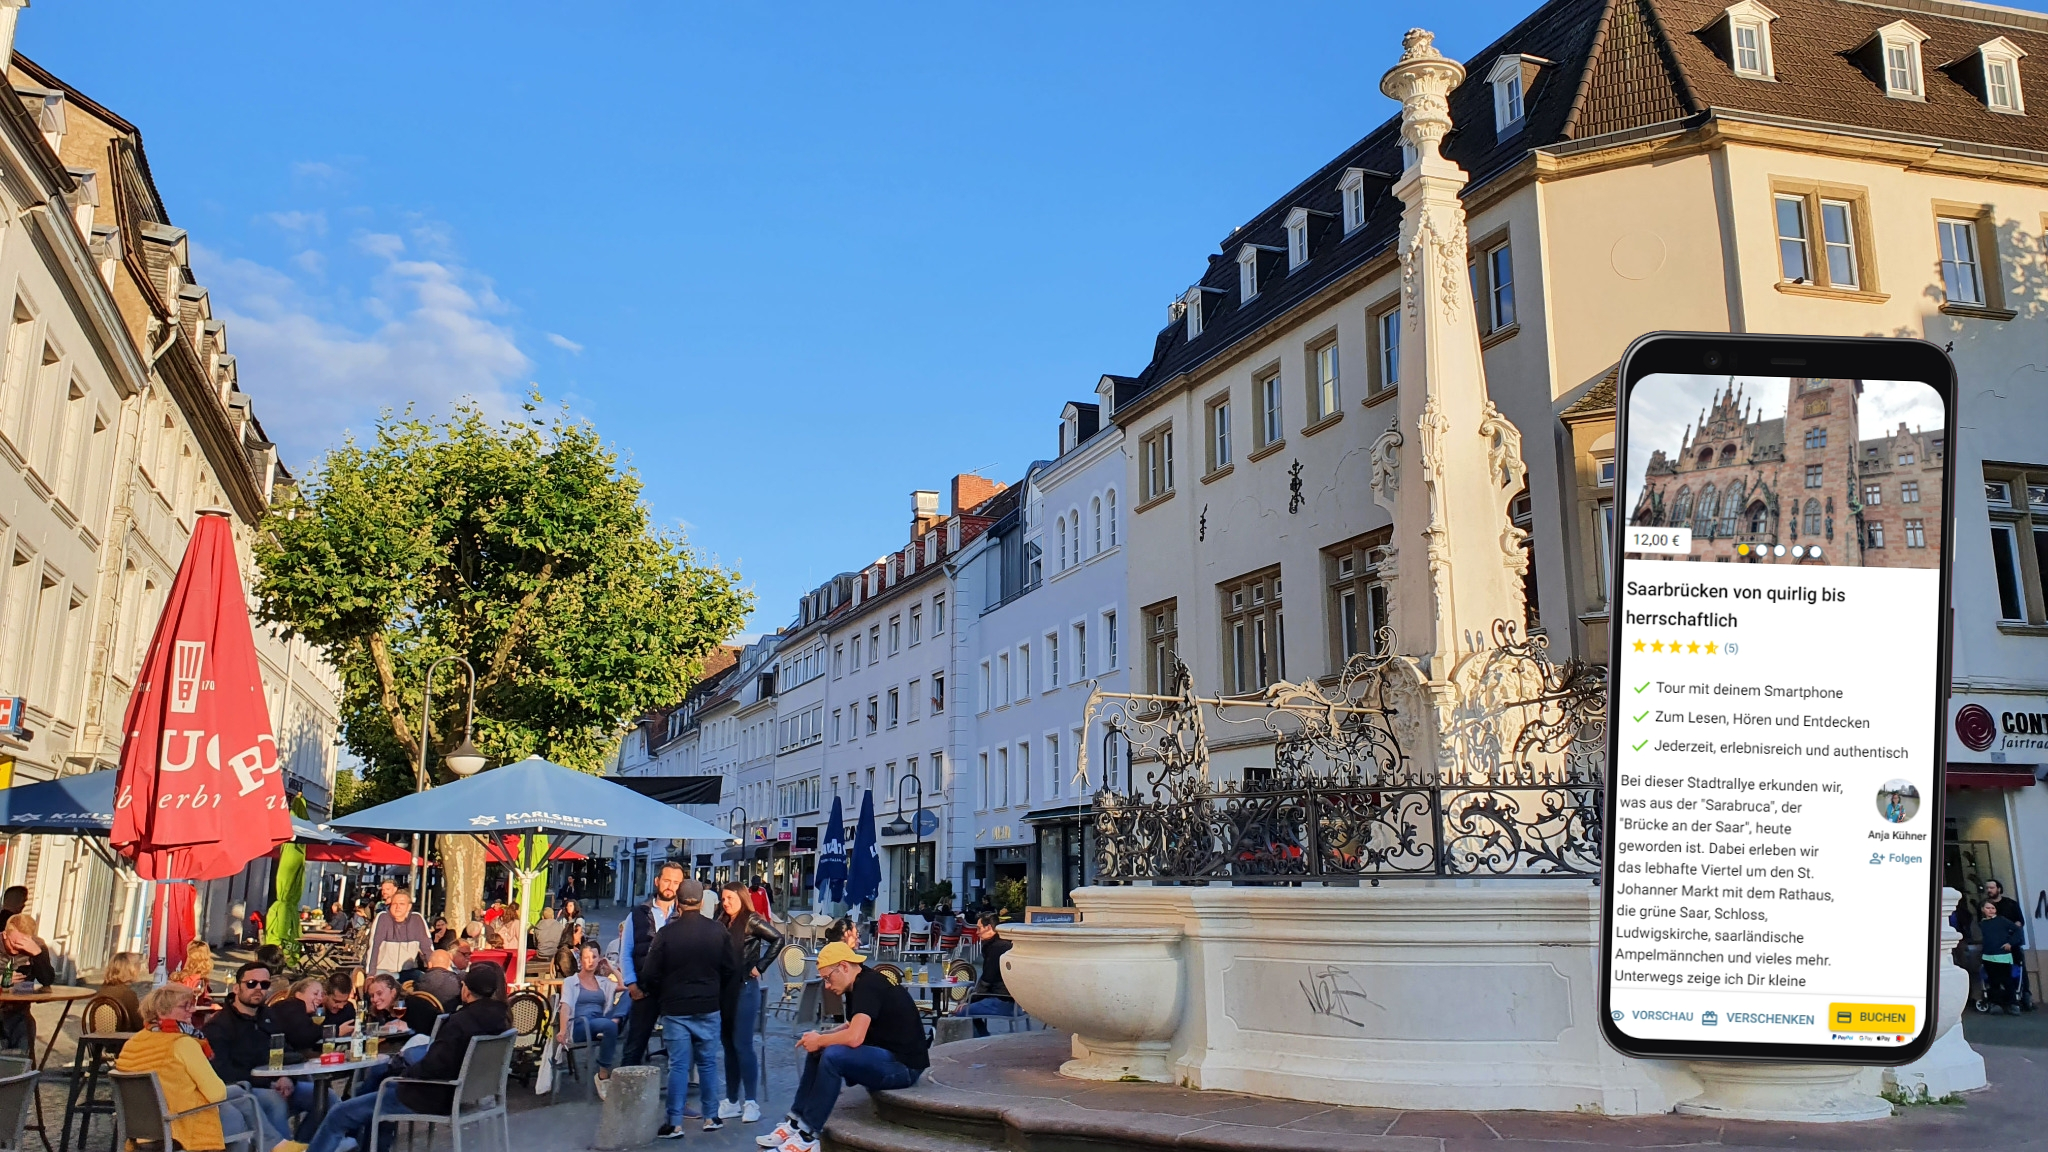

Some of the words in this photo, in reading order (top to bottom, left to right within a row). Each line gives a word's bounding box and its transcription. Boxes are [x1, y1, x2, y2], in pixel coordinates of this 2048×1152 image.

[1634, 534, 1668, 546] 12,00
[1671, 534, 1680, 546] €
[1627, 581, 1728, 598] Saarbrücken
[1733, 588, 1761, 599] von
[1767, 586, 1816, 604] quirlig
[1822, 587, 1845, 602] bis
[1626, 610, 1737, 627] herrschaftlich
[1724, 642, 1739, 655] (5)
[1656, 682, 1685, 693] Tour
[1689, 683, 1709, 694] mit
[1714, 683, 1760, 696] deinem
[1765, 685, 1843, 700] Smartphone
[1655, 711, 1684, 722] Zum
[1689, 712, 1729, 725] Lesen,
[1734, 714, 1771, 725] Hören
[1776, 715, 1799, 726] und
[1804, 716, 1869, 728] Entdecken
[1655, 740, 1716, 754] Jederzeit,
[1720, 742, 1801, 755] erlebnisreich
[1806, 745, 1829, 756] und
[1834, 746, 1908, 758] authentisch
[1621, 775, 1640, 786] Bei
[1645, 775, 1684, 787] dieser
[1688, 777, 1755, 792] Stadtrallye
[1759, 779, 1817, 791] erkunden
[1822, 782, 1843, 794] wir,
[1620, 799, 1646, 808] was
[1650, 800, 1672, 809] aus
[1677, 798, 1697, 810] der
[1701, 799, 1777, 814] "Sarabruca",
[1782, 802, 1802, 813] der
[50, 812, 114, 821] KARLS
[505, 811, 608, 827] KARLSBERG
[1620, 818, 1668, 830] "Brücke
[1672, 822, 1687, 831] an
[1691, 820, 1712, 832] der
[1716, 821, 1751, 834] Saar",
[1756, 822, 1791, 834] heute
[1868, 831, 1889, 841] Anja
[1893, 831, 1926, 840] Kühner
[1619, 841, 1681, 854] geworden
[1686, 842, 1704, 853] ist.
[1709, 843, 1744, 854] Dabei
[1749, 844, 1796, 856] erleben
[1800, 846, 1819, 856] wir
[1889, 854, 1922, 864] Folgen
[1618, 861, 1641, 873] das
[1646, 862, 1697, 875] lebhafte
[1701, 864, 1742, 876] Viertel
[1747, 868, 1766, 877] um
[1771, 866, 1793, 878] den
[1798, 867, 1813, 878] St.
[1617, 883, 1678, 896] Johanner
[1682, 885, 1718, 897] Markt
[1723, 887, 1743, 898] mit
[1747, 887, 1775, 899] dem
[1779, 888, 1834, 902] Rathaus,
[1617, 904, 1636, 916] die
[1640, 906, 1676, 919] grüne
[1680, 907, 1710, 920] Saar,
[1715, 908, 1767, 922] Schloss,
[1617, 927, 1710, 942] Ludwigskirche,
[1715, 930, 1804, 943] saarländische
[1615, 948, 1723, 962] Ampelmännchen
[1728, 952, 1751, 963] und
[1756, 953, 1792, 965] vieles
[1796, 954, 1830, 966] mehr.
[1615, 970, 1683, 985] Unterwegs
[1687, 973, 1720, 986] zeige
[1725, 973, 1743, 984] ich
[1748, 974, 1765, 985] Dir
[1769, 974, 1806, 986] kleine
[1632, 1011, 1694, 1022] VORSCHAU
[1727, 1013, 1814, 1025] VERSCHENKEN
[1860, 1012, 1906, 1022] BUCHEN
